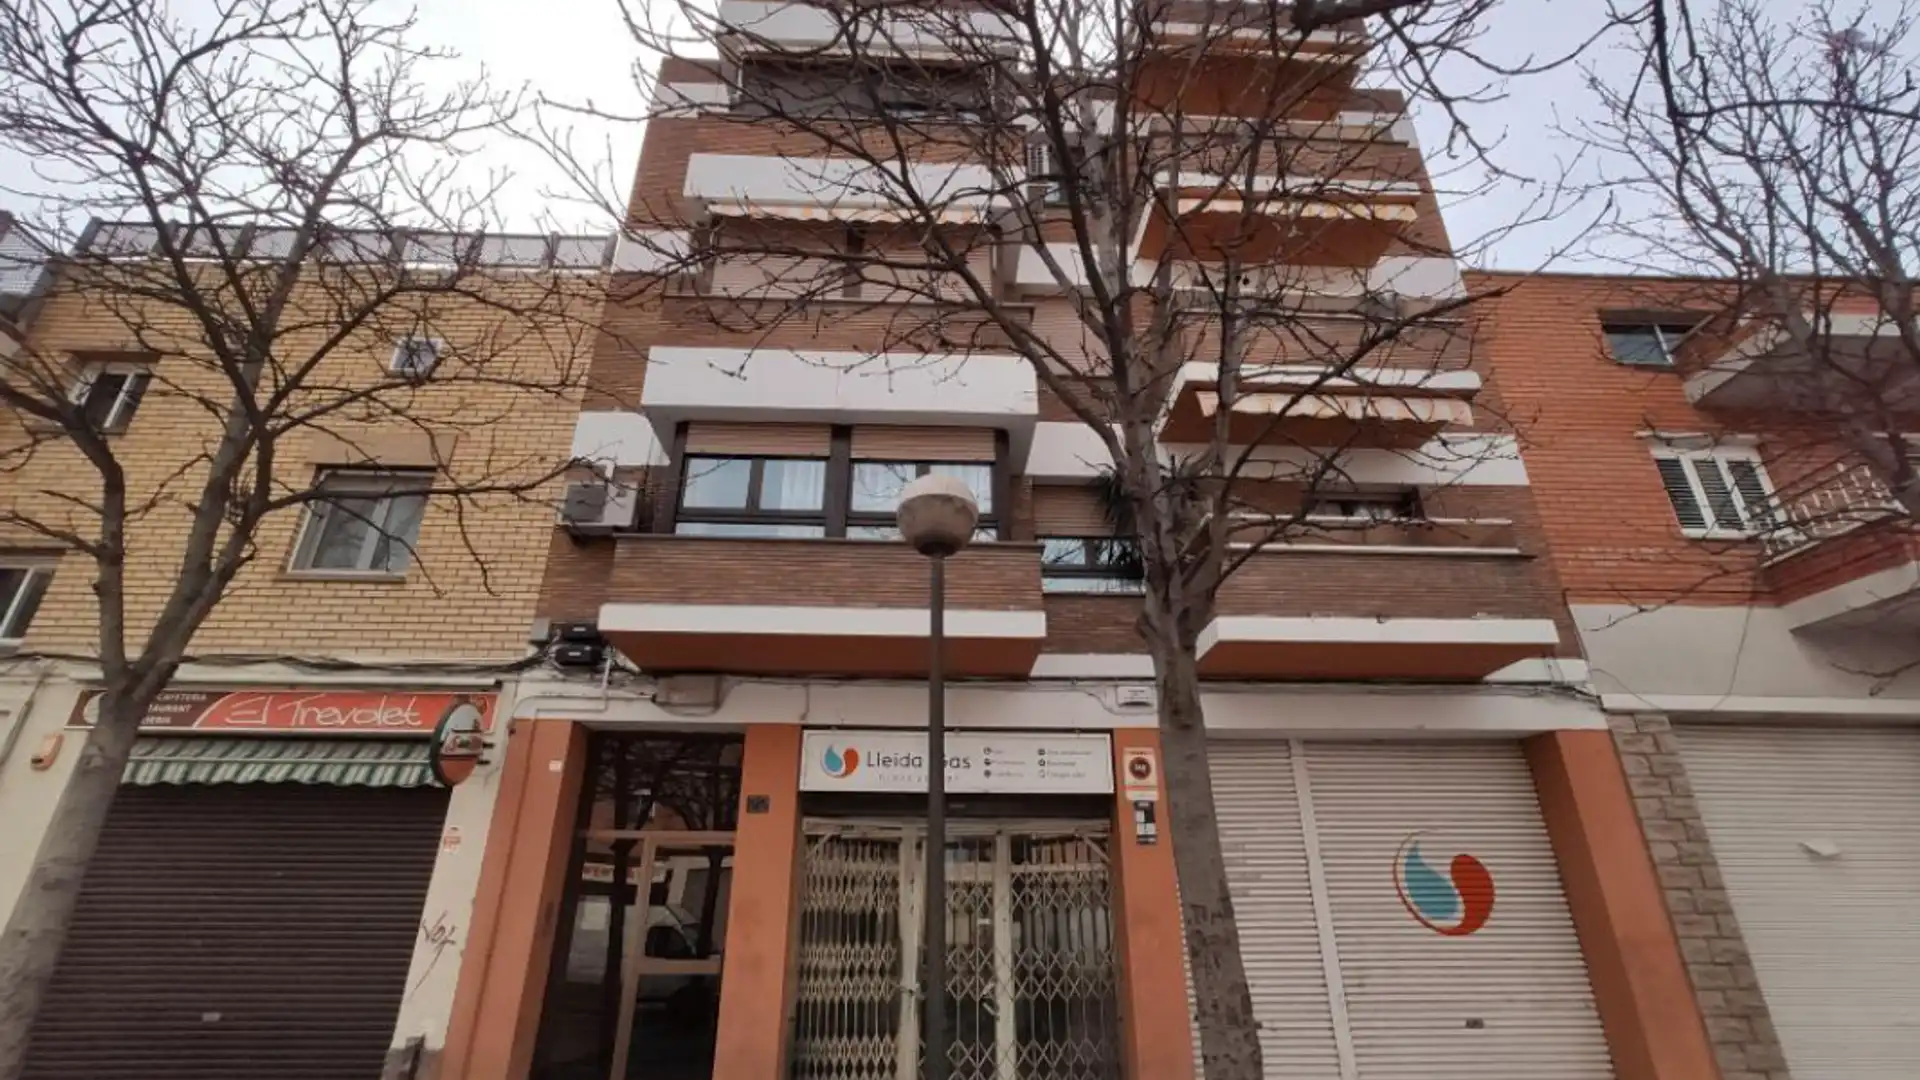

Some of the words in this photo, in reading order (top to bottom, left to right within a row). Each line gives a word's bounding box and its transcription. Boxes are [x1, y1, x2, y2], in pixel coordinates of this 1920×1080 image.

[225, 695, 273, 725] El
[278, 693, 423, 726] Trevolet
[867, 750, 922, 769] Lleida
[944, 754, 972, 770] as
